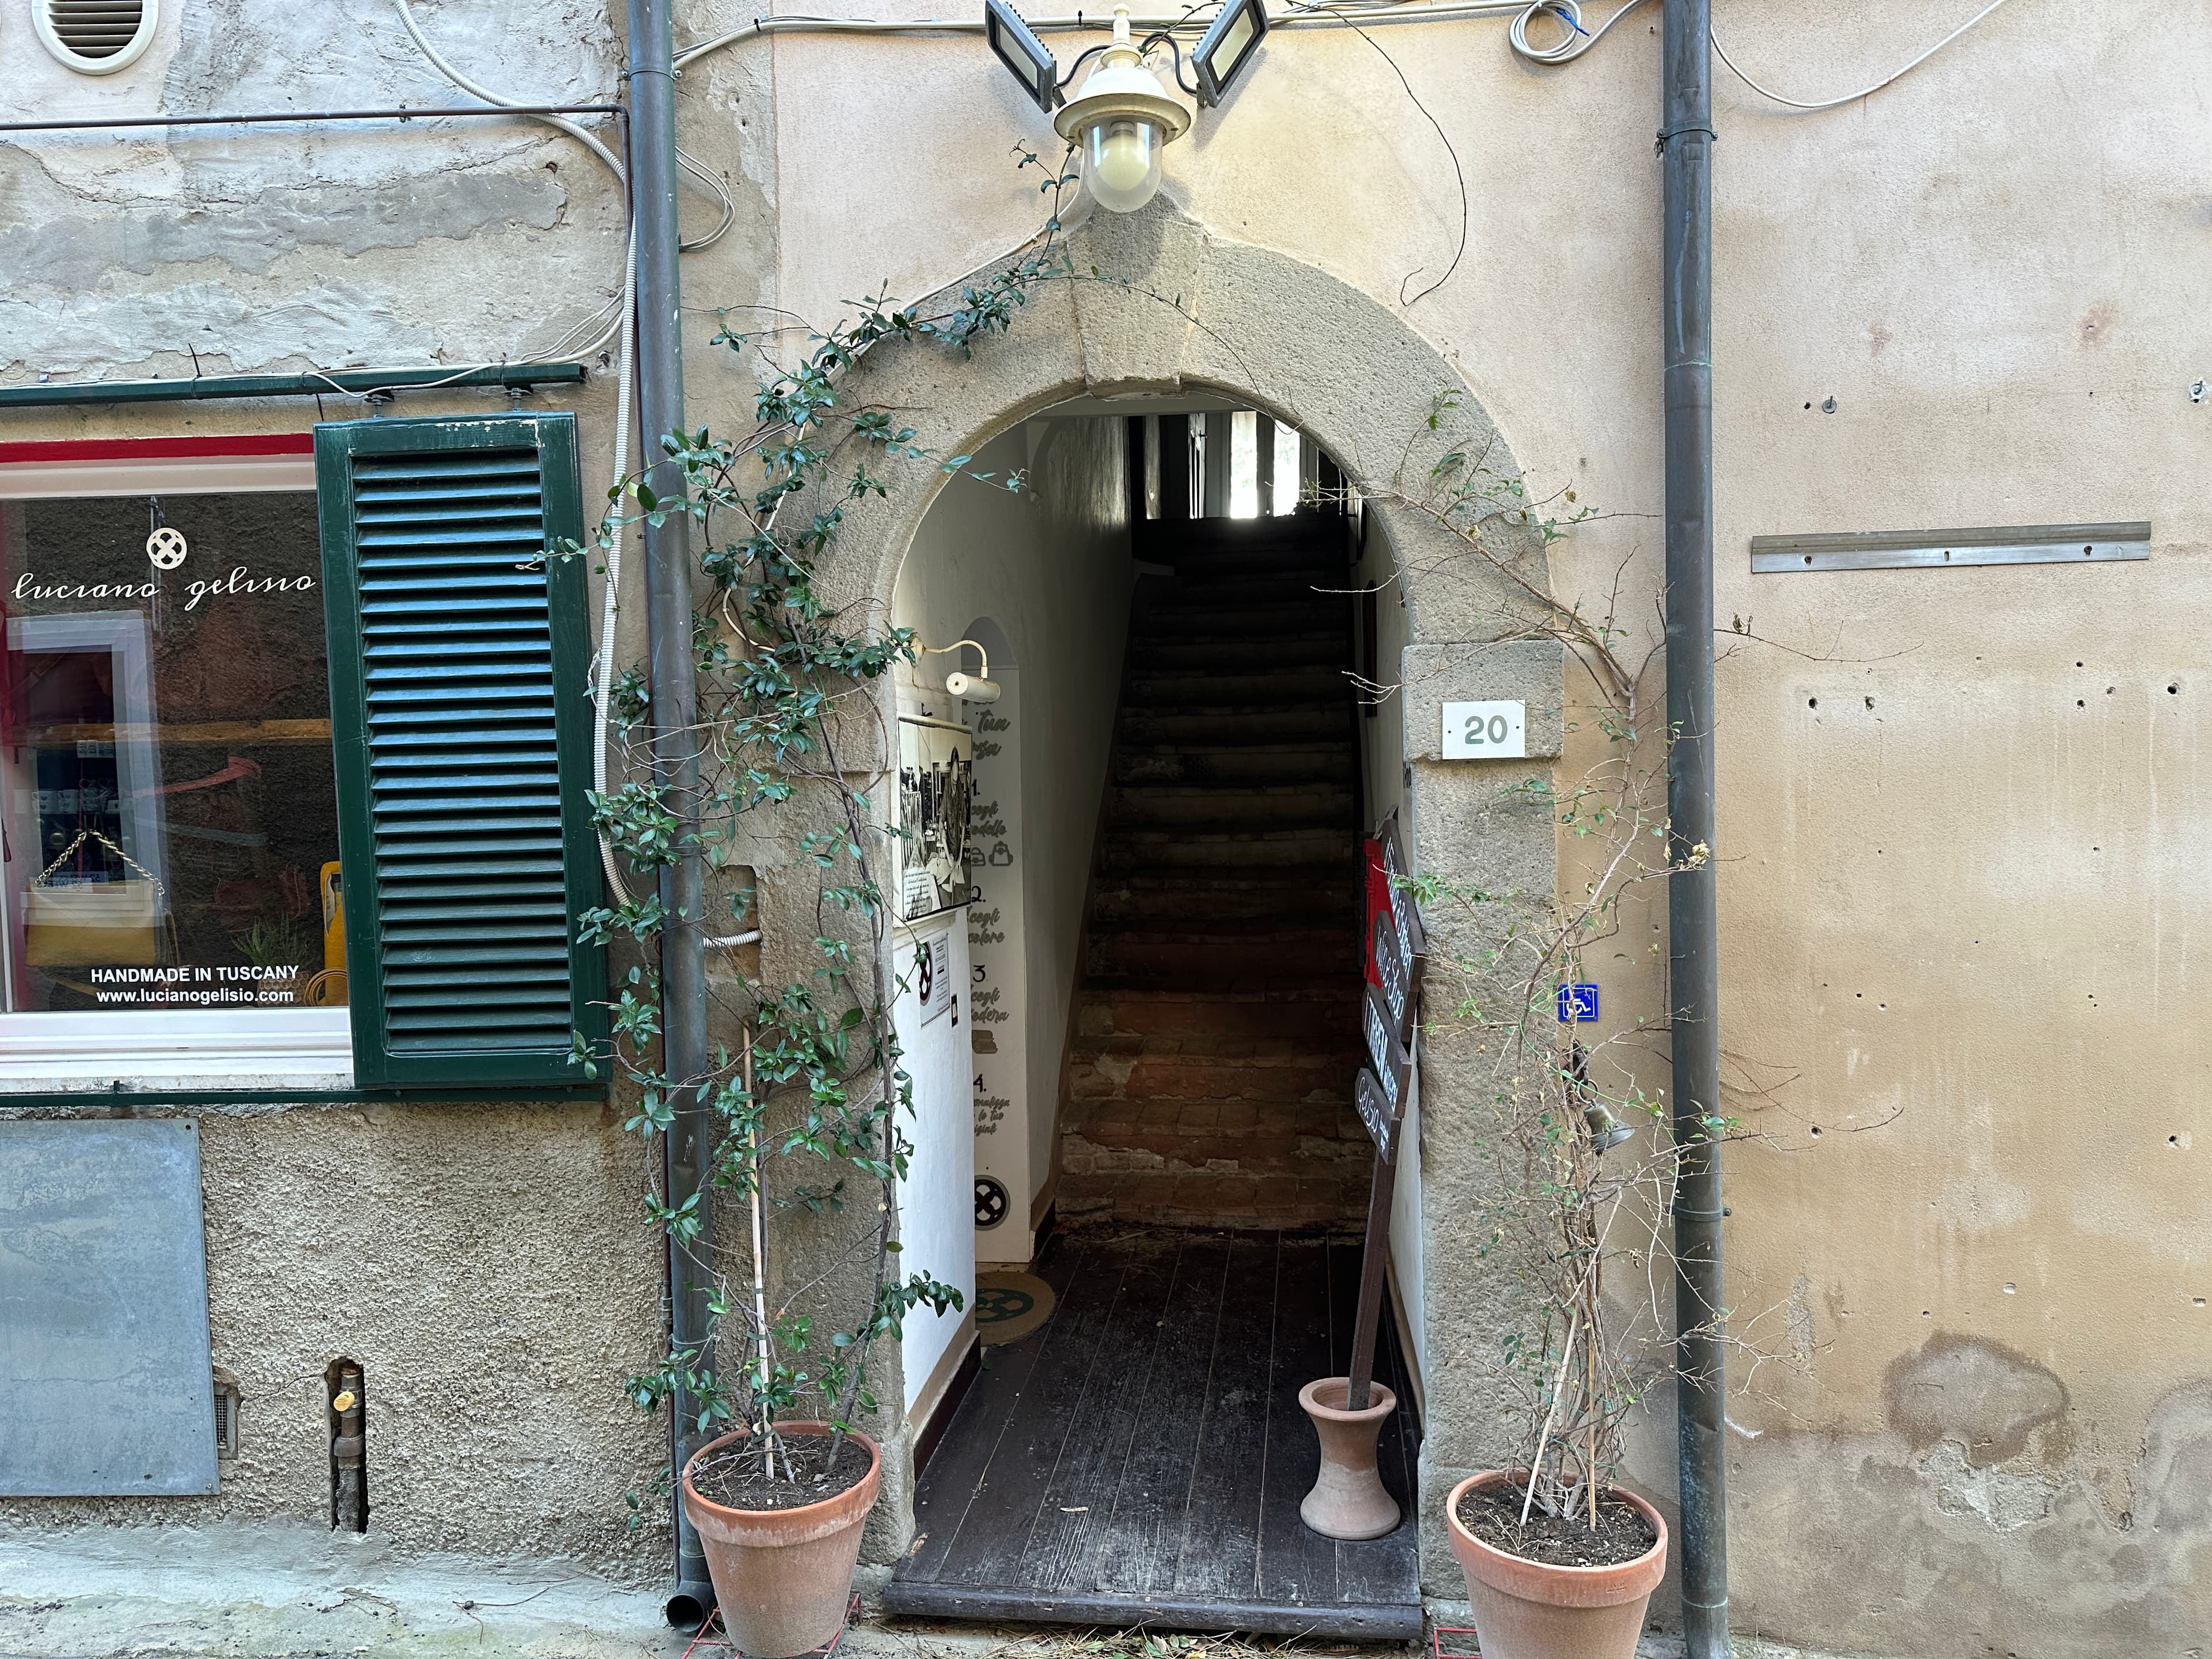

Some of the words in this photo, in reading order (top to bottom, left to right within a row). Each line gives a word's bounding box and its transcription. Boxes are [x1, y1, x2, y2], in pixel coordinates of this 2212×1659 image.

[11, 573, 160, 599] luciano
[184, 566, 316, 611] gelisio
[978, 709, 1011, 734] Tua
[1465, 714, 1509, 744] 20
[971, 800, 999, 820] cegli
[971, 819, 1007, 838] odello
[971, 885, 986, 903] 2.
[967, 906, 1001, 929] cegli
[91, 968, 191, 983] HANDMADE
[195, 968, 212, 982] IN
[216, 965, 300, 981] TUSCANY
[96, 987, 294, 1005] www.lucianogelisio.com
[971, 984, 1001, 1007] cegli
[971, 1007, 1010, 1024] odera
[973, 1074, 987, 1093] 4.
